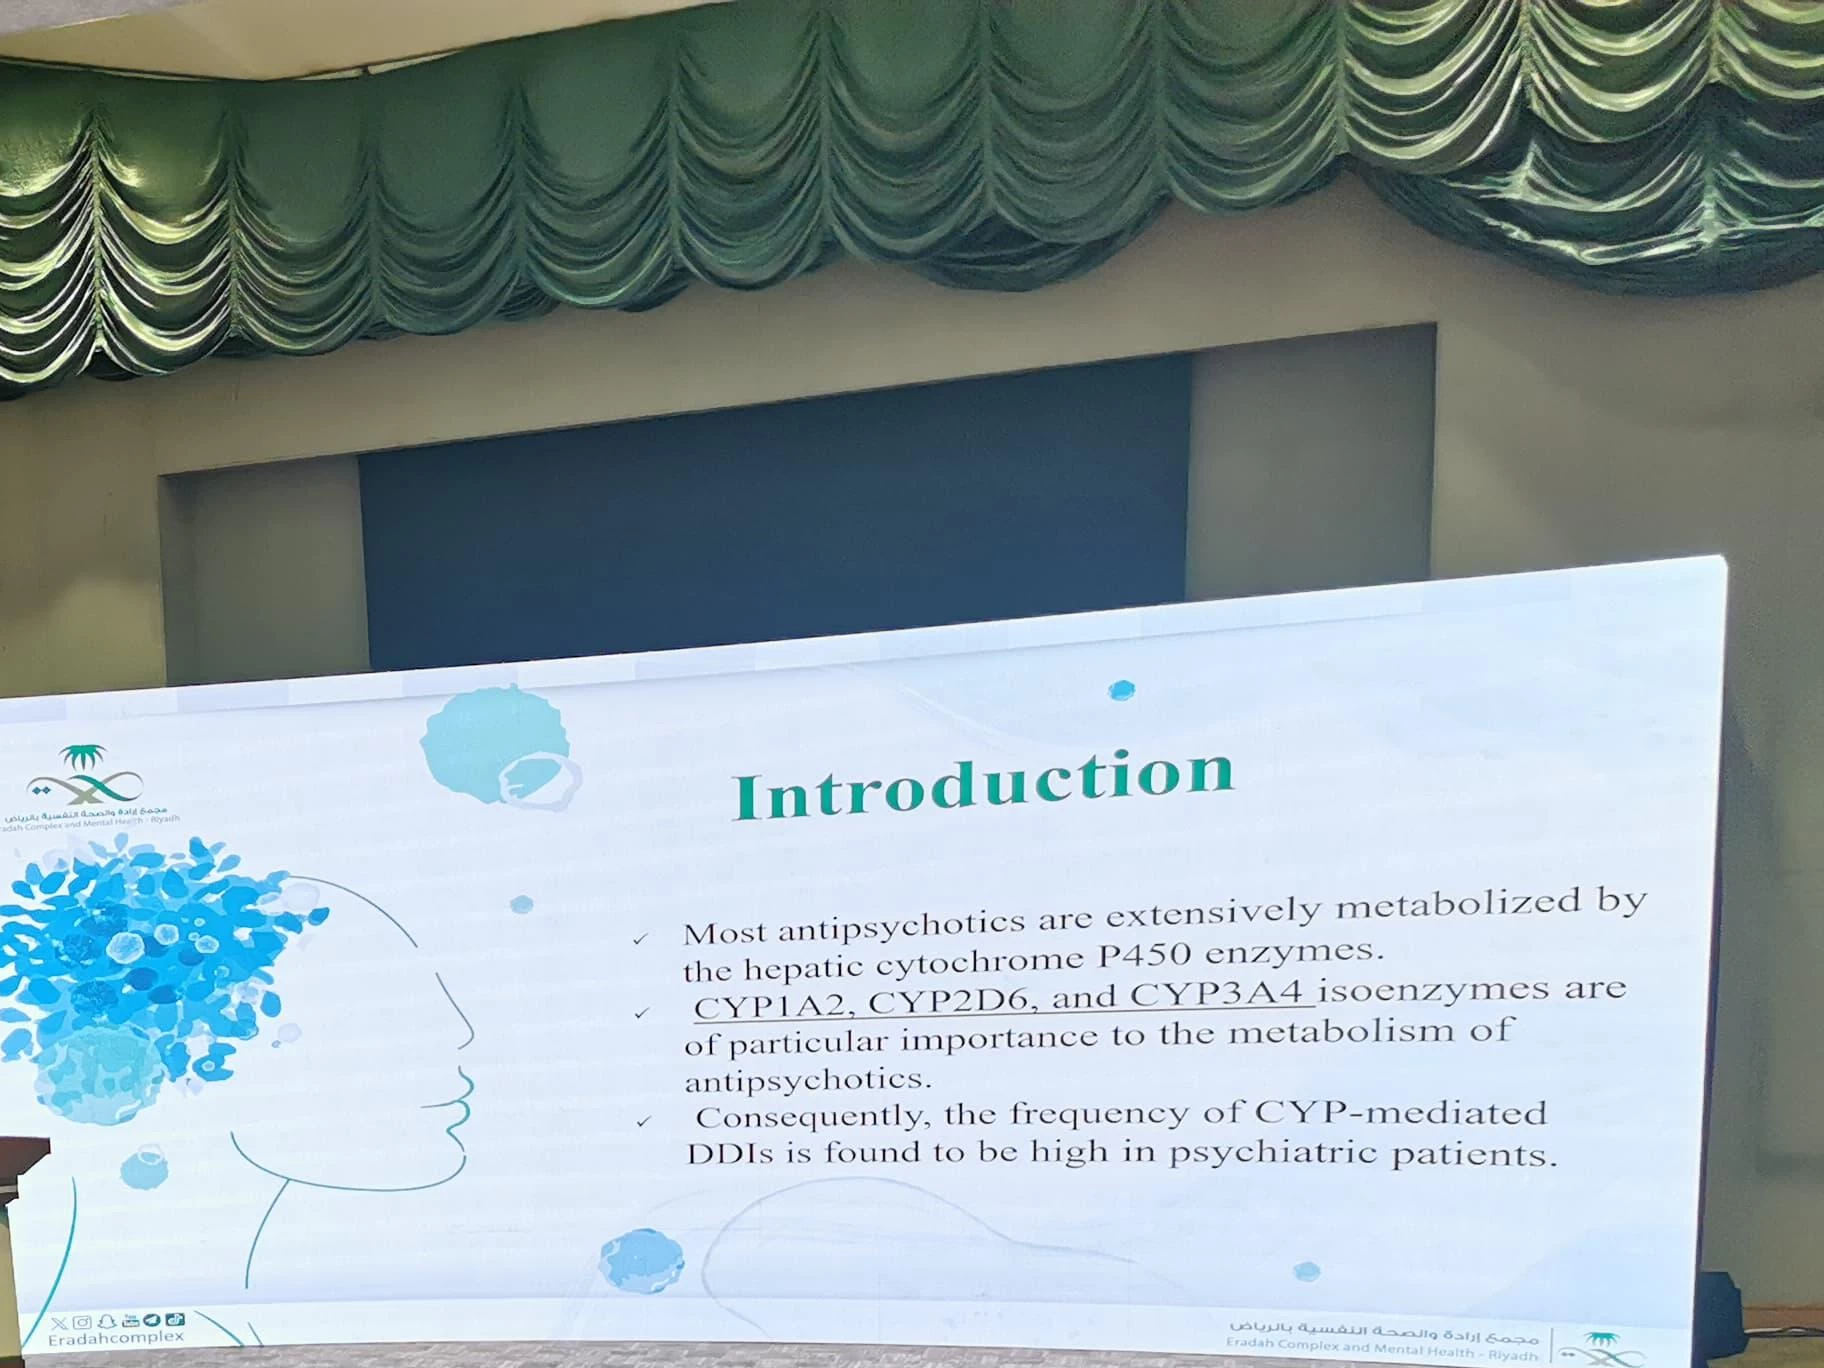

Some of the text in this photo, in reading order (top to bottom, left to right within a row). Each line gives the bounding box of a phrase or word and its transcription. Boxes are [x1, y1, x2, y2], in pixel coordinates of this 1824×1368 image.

[731, 748, 1236, 822] Introduction
[683, 884, 1649, 946] Most antipsychotics are extensively metabolized by
[682, 942, 1384, 986] the hepatic cytochrome P450 enzymes.
[694, 977, 1627, 1020] CYP1A2, CYP2D6, and CYP3A4 isoenzymes are
[684, 1015, 1518, 1062] of particular importance to the metabolism of
[685, 1065, 932, 1098] antipsychotics.
[696, 1098, 1548, 1134] Consequently, the frequency of CYP-mediated
[687, 1138, 1558, 1172] DDIs is found to be high in psychiatric patients.
[48, 1330, 185, 1347] Eradahcomplex
[1229, 1320, 1293, 1334] بالرياض
[1297, 1321, 1367, 1336] النفسية
[1372, 1325, 1439, 1340] والصحة
[1485, 1333, 1539, 1346] مجمع
[1226, 1336, 1275, 1348] Eradah
[1278, 1338, 1341, 1352] Complex
[1343, 1343, 1370, 1353] and
[1374, 1343, 1424, 1355] Mental
[1427, 1347, 1475, 1359] Health
[1488, 1350, 1539, 1363] Riyadh
